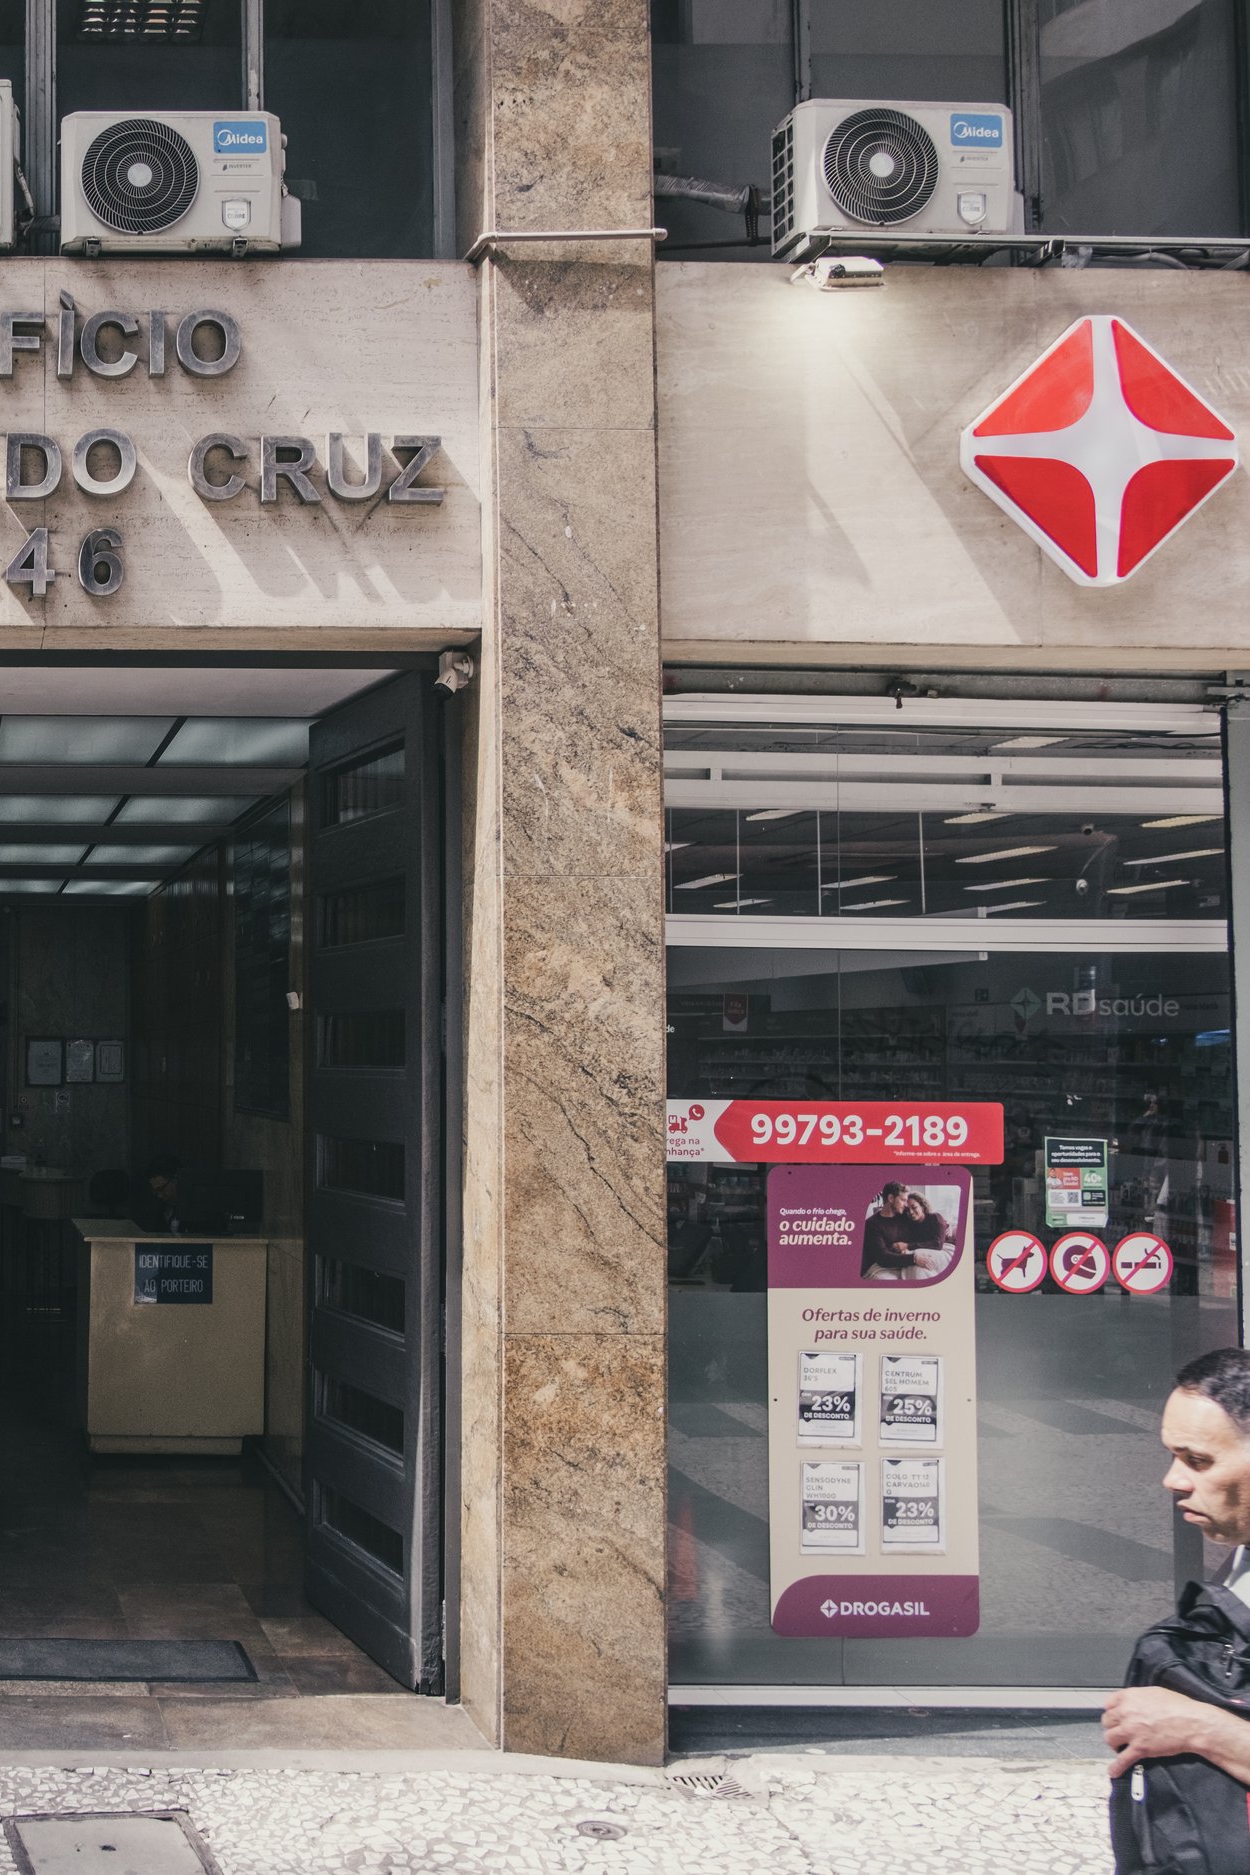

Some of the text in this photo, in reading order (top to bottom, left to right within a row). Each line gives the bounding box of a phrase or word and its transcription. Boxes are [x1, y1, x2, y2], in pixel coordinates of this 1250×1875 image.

[217, 129, 263, 146] Midea
[953, 121, 999, 139] Midea
[187, 431, 445, 505] CRUZ
[5, 527, 124, 598] 46
[750, 1113, 968, 1147] 99793-2189
[779, 1208, 806, 1216] Quando
[812, 1208, 824, 1216] frio
[825, 1208, 847, 1216] chega,
[779, 1217, 855, 1232] o cuidado
[779, 1232, 852, 1246] aumenta.
[139, 1254, 208, 1269] IDENTIFIQUE-SE
[144, 1279, 204, 1293] AO PORTEIRO
[802, 1308, 941, 1322] Ofertas de inverno
[814, 1326, 927, 1343] para sua saúde.
[884, 1370, 923, 1378] CENTRUM
[811, 1395, 851, 1412] 23%
[893, 1398, 932, 1415] 25%
[813, 1412, 850, 1420] DESCONTO
[814, 1505, 855, 1521] 30%
[895, 1501, 934, 1517] 23%
[840, 1602, 930, 1616] DROGASIL
